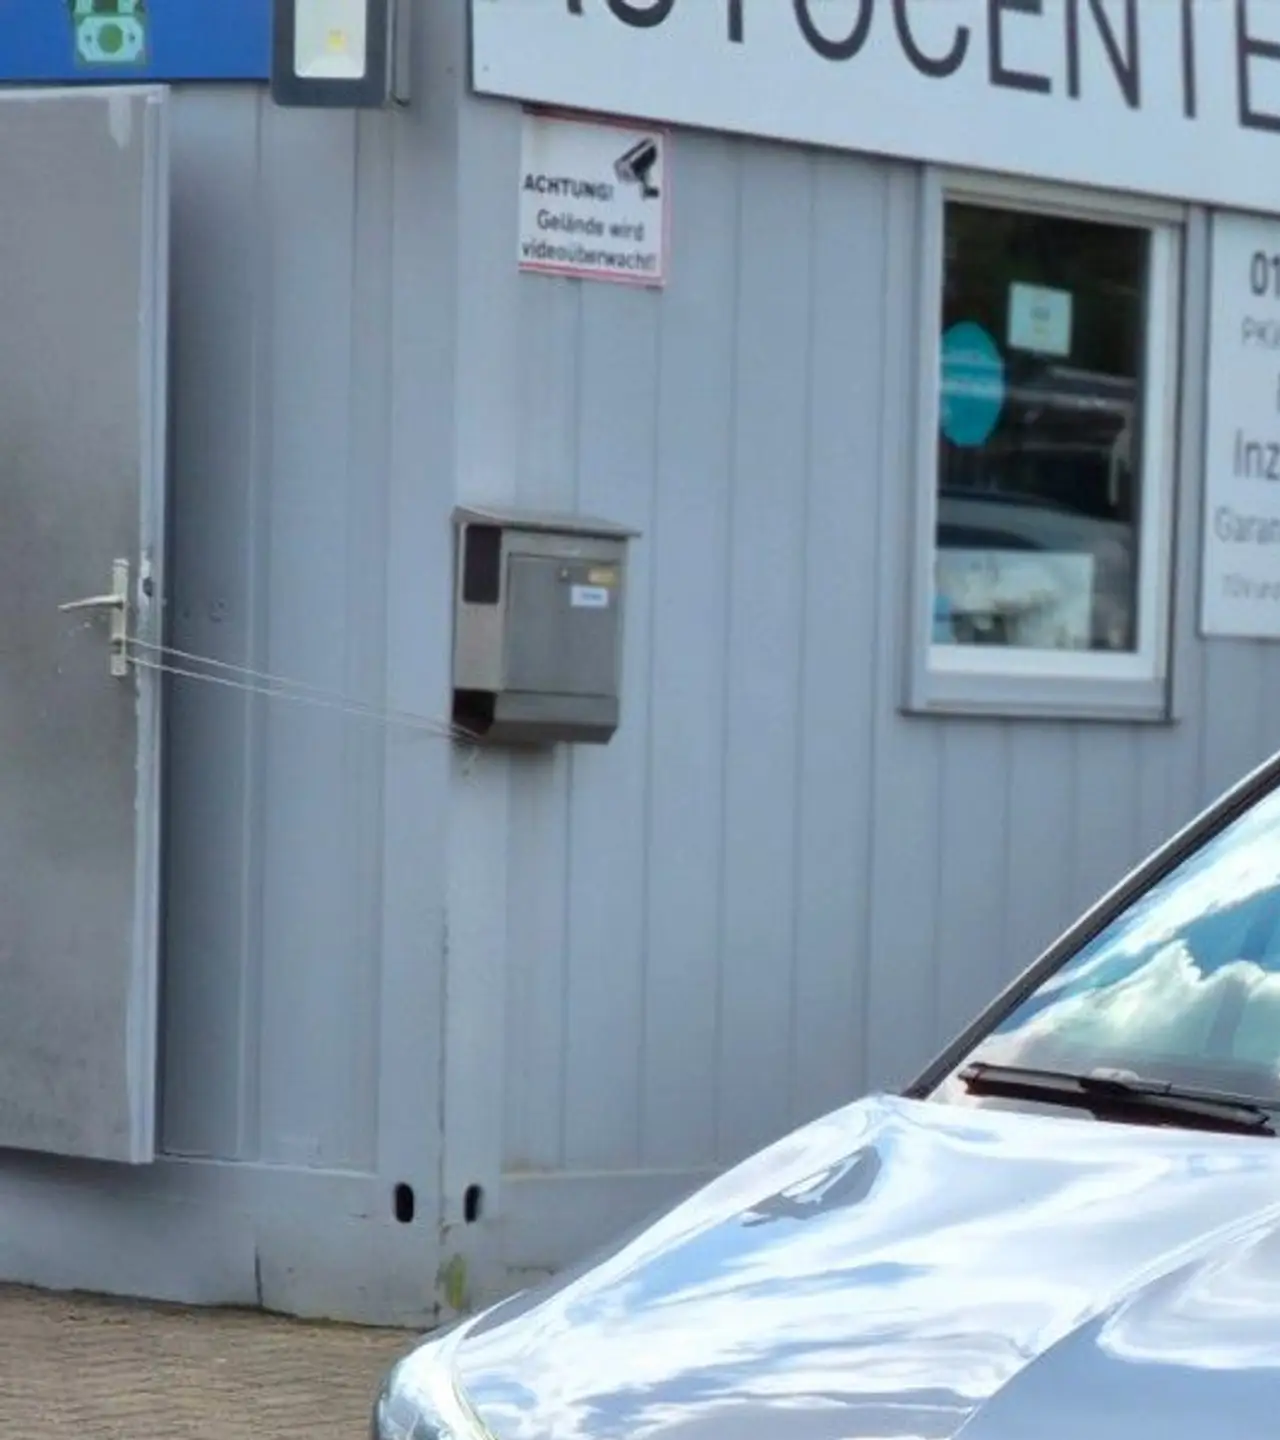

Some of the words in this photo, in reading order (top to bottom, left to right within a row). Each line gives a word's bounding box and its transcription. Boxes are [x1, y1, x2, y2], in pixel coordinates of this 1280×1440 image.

[523, 173, 614, 201] ACHTUNG!
[537, 208, 604, 236] Gelände
[609, 216, 645, 242] wird
